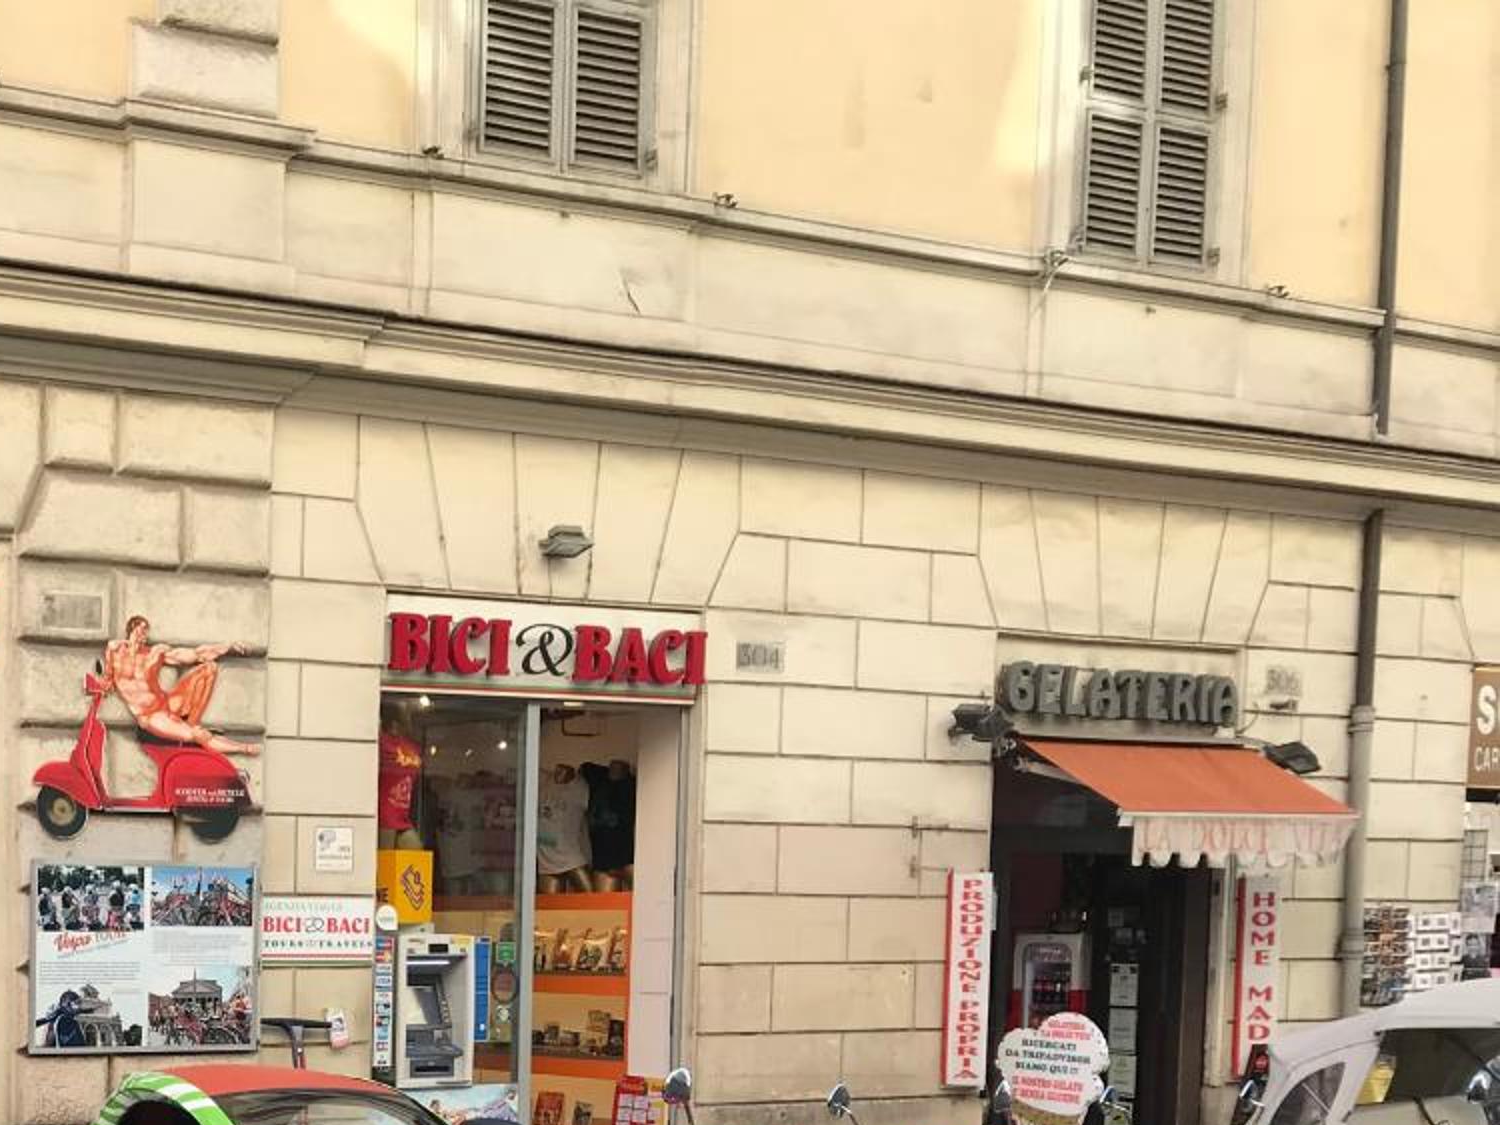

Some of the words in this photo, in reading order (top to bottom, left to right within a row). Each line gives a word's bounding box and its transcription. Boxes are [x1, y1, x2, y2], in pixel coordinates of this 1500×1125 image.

[386, 612, 513, 677] BICI
[515, 623, 574, 677] &
[571, 625, 709, 687] BACI
[1005, 660, 1239, 727] GELATERIA
[263, 917, 302, 933] BICI
[327, 918, 369, 933] BACI
[956, 879, 984, 994] PRODUZIONE
[1251, 892, 1276, 966] HOME
[953, 1000, 981, 1080] PROPRIA
[1248, 986, 1273, 1042] MAD
